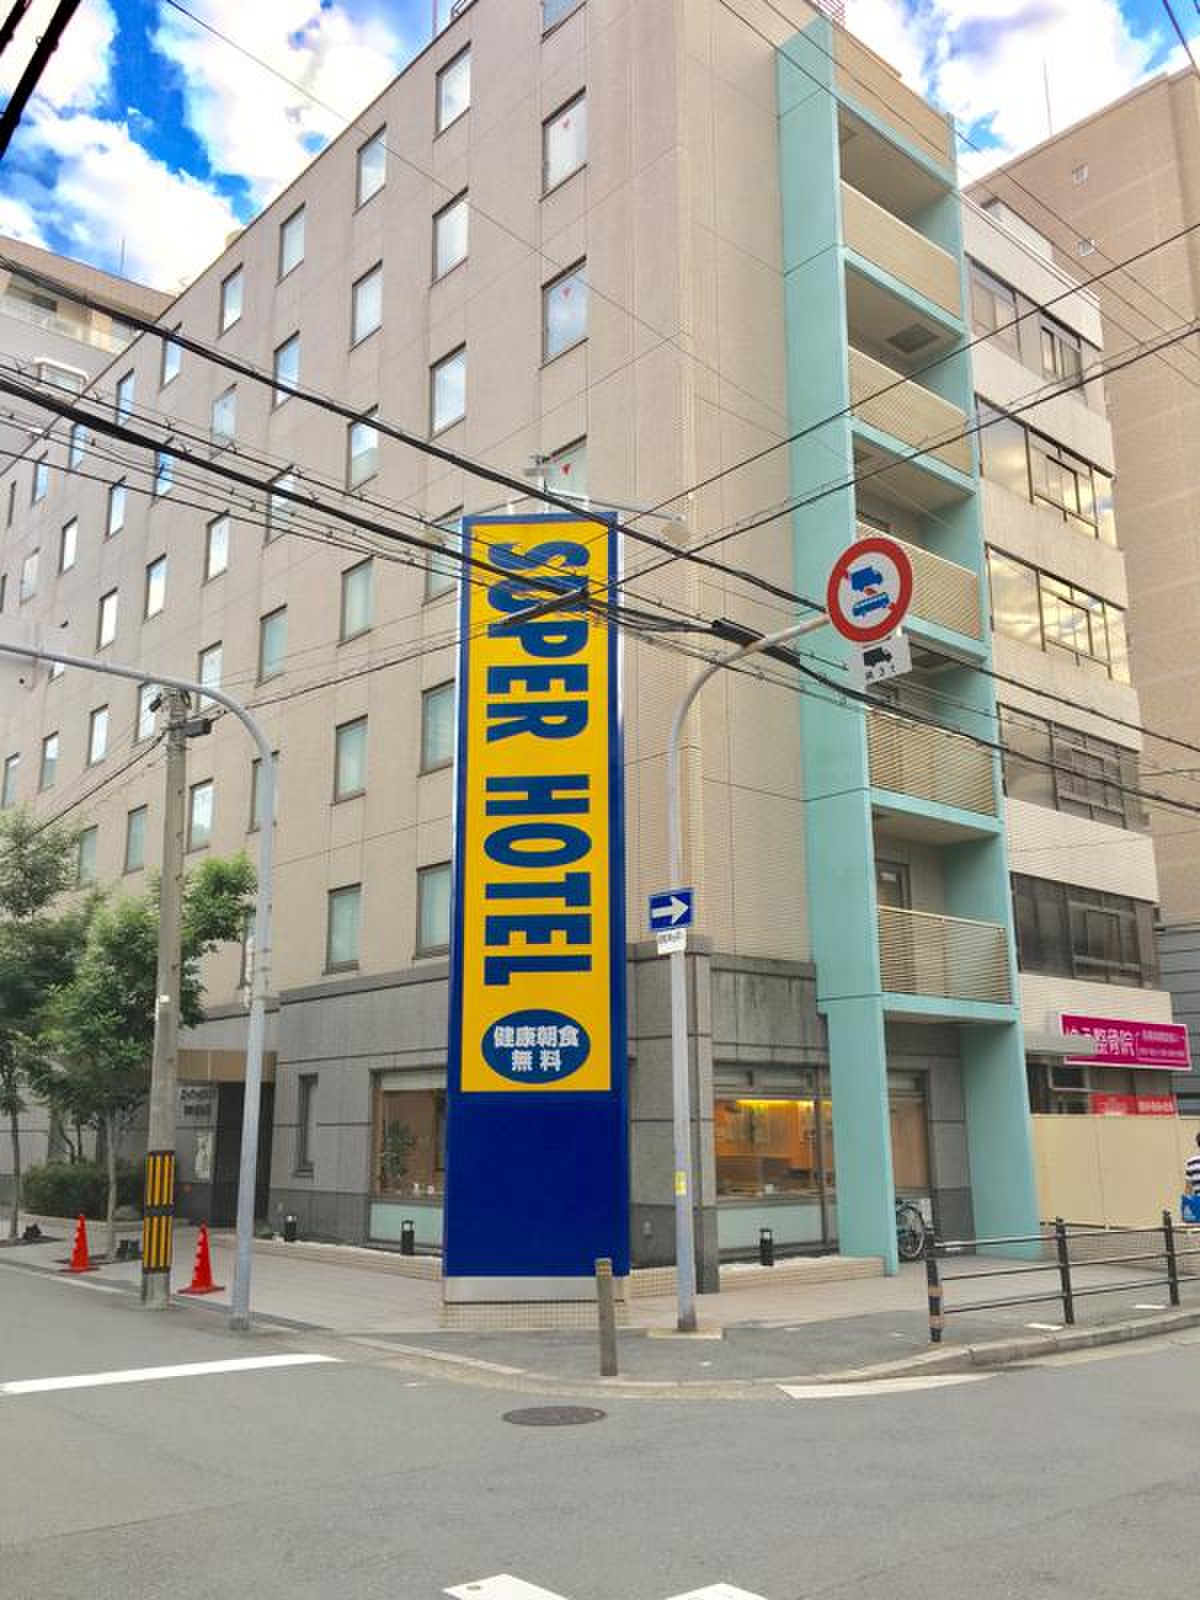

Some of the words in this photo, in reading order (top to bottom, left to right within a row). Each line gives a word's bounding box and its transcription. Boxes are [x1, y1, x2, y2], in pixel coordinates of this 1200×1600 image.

[487, 541, 590, 743] SUPER
[484, 774, 592, 985] HOTEL
[493, 1025, 579, 1048] 健康朝食
[511, 1049, 562, 1072] 無料
